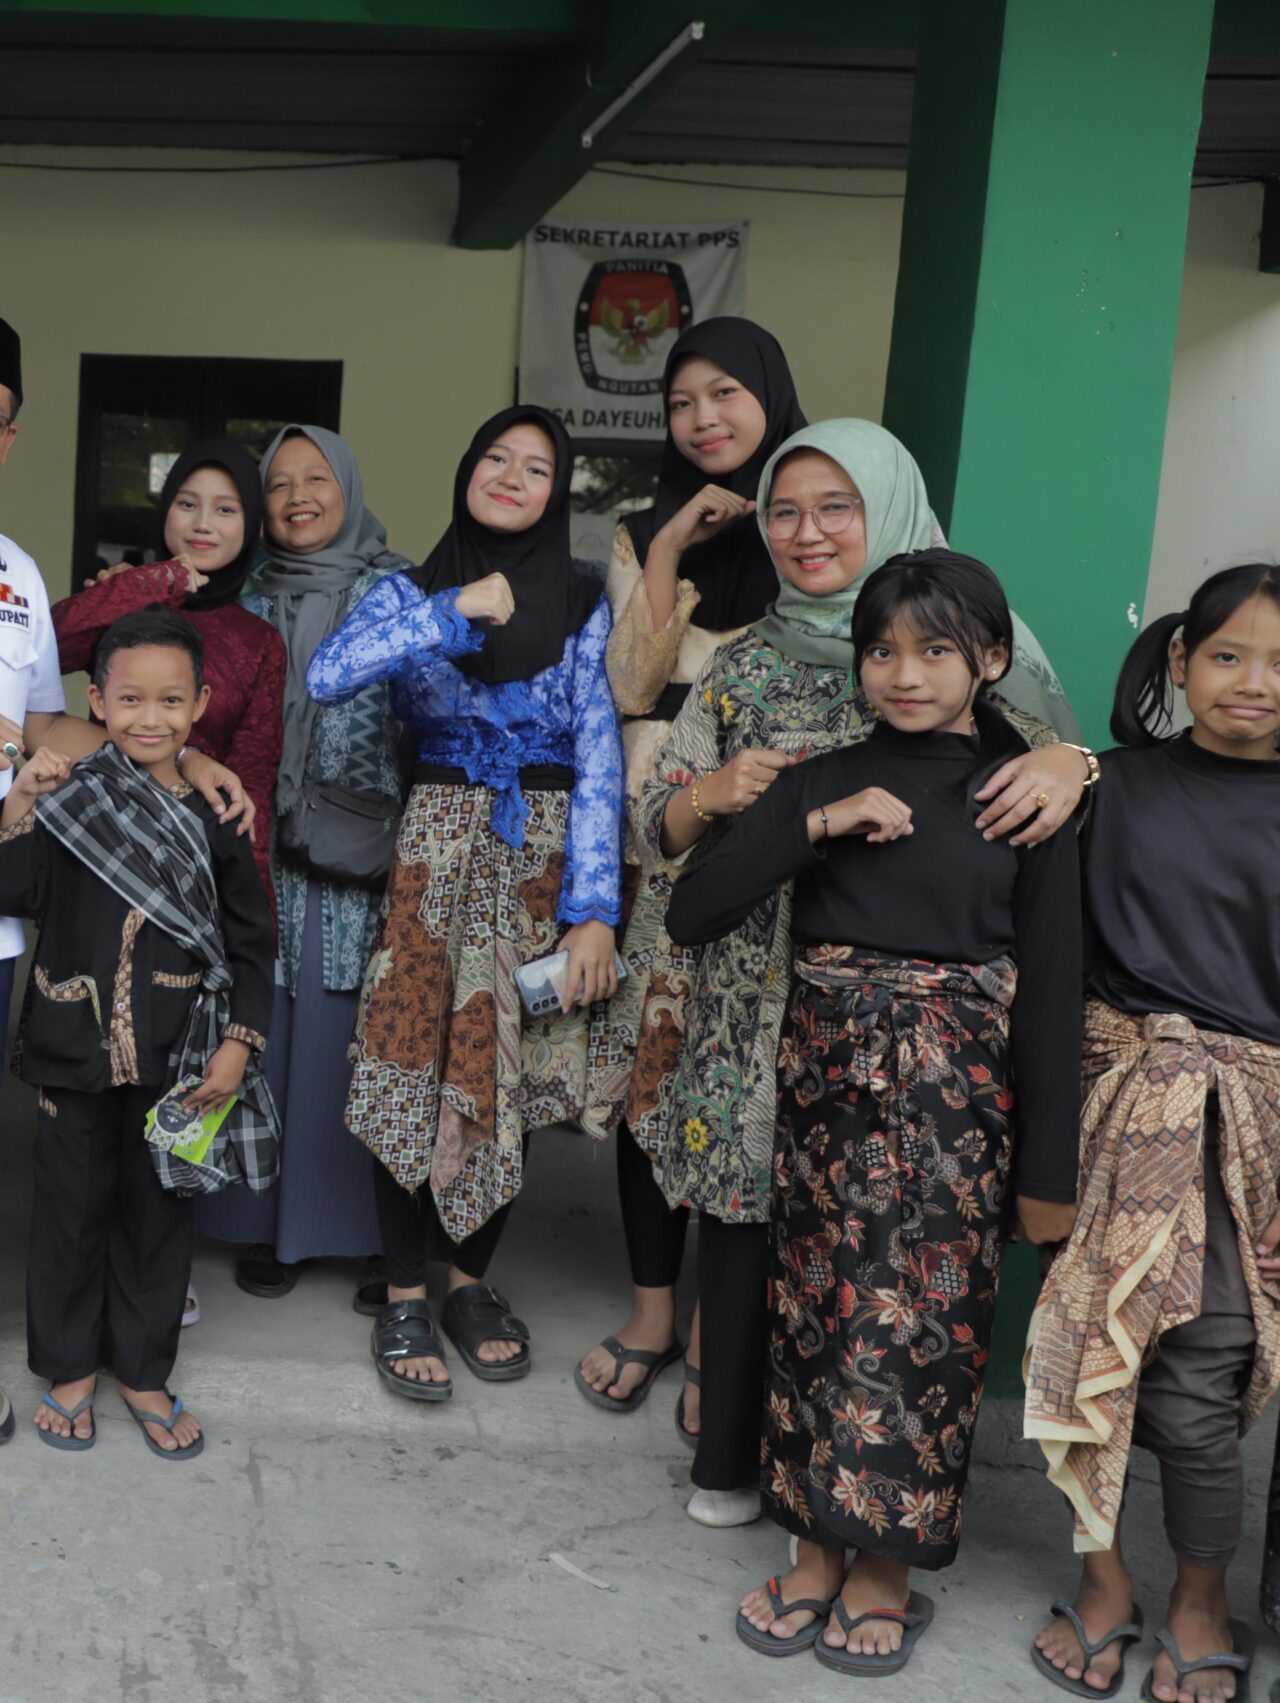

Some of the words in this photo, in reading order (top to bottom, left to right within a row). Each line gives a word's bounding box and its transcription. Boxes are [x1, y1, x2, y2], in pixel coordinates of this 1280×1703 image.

[535, 225, 690, 249] SEKRETARIAT
[698, 231, 740, 248] PPS
[606, 261, 669, 273] PANITIA
[546, 408, 576, 427] SA
[582, 409, 667, 430] DAYEUH
